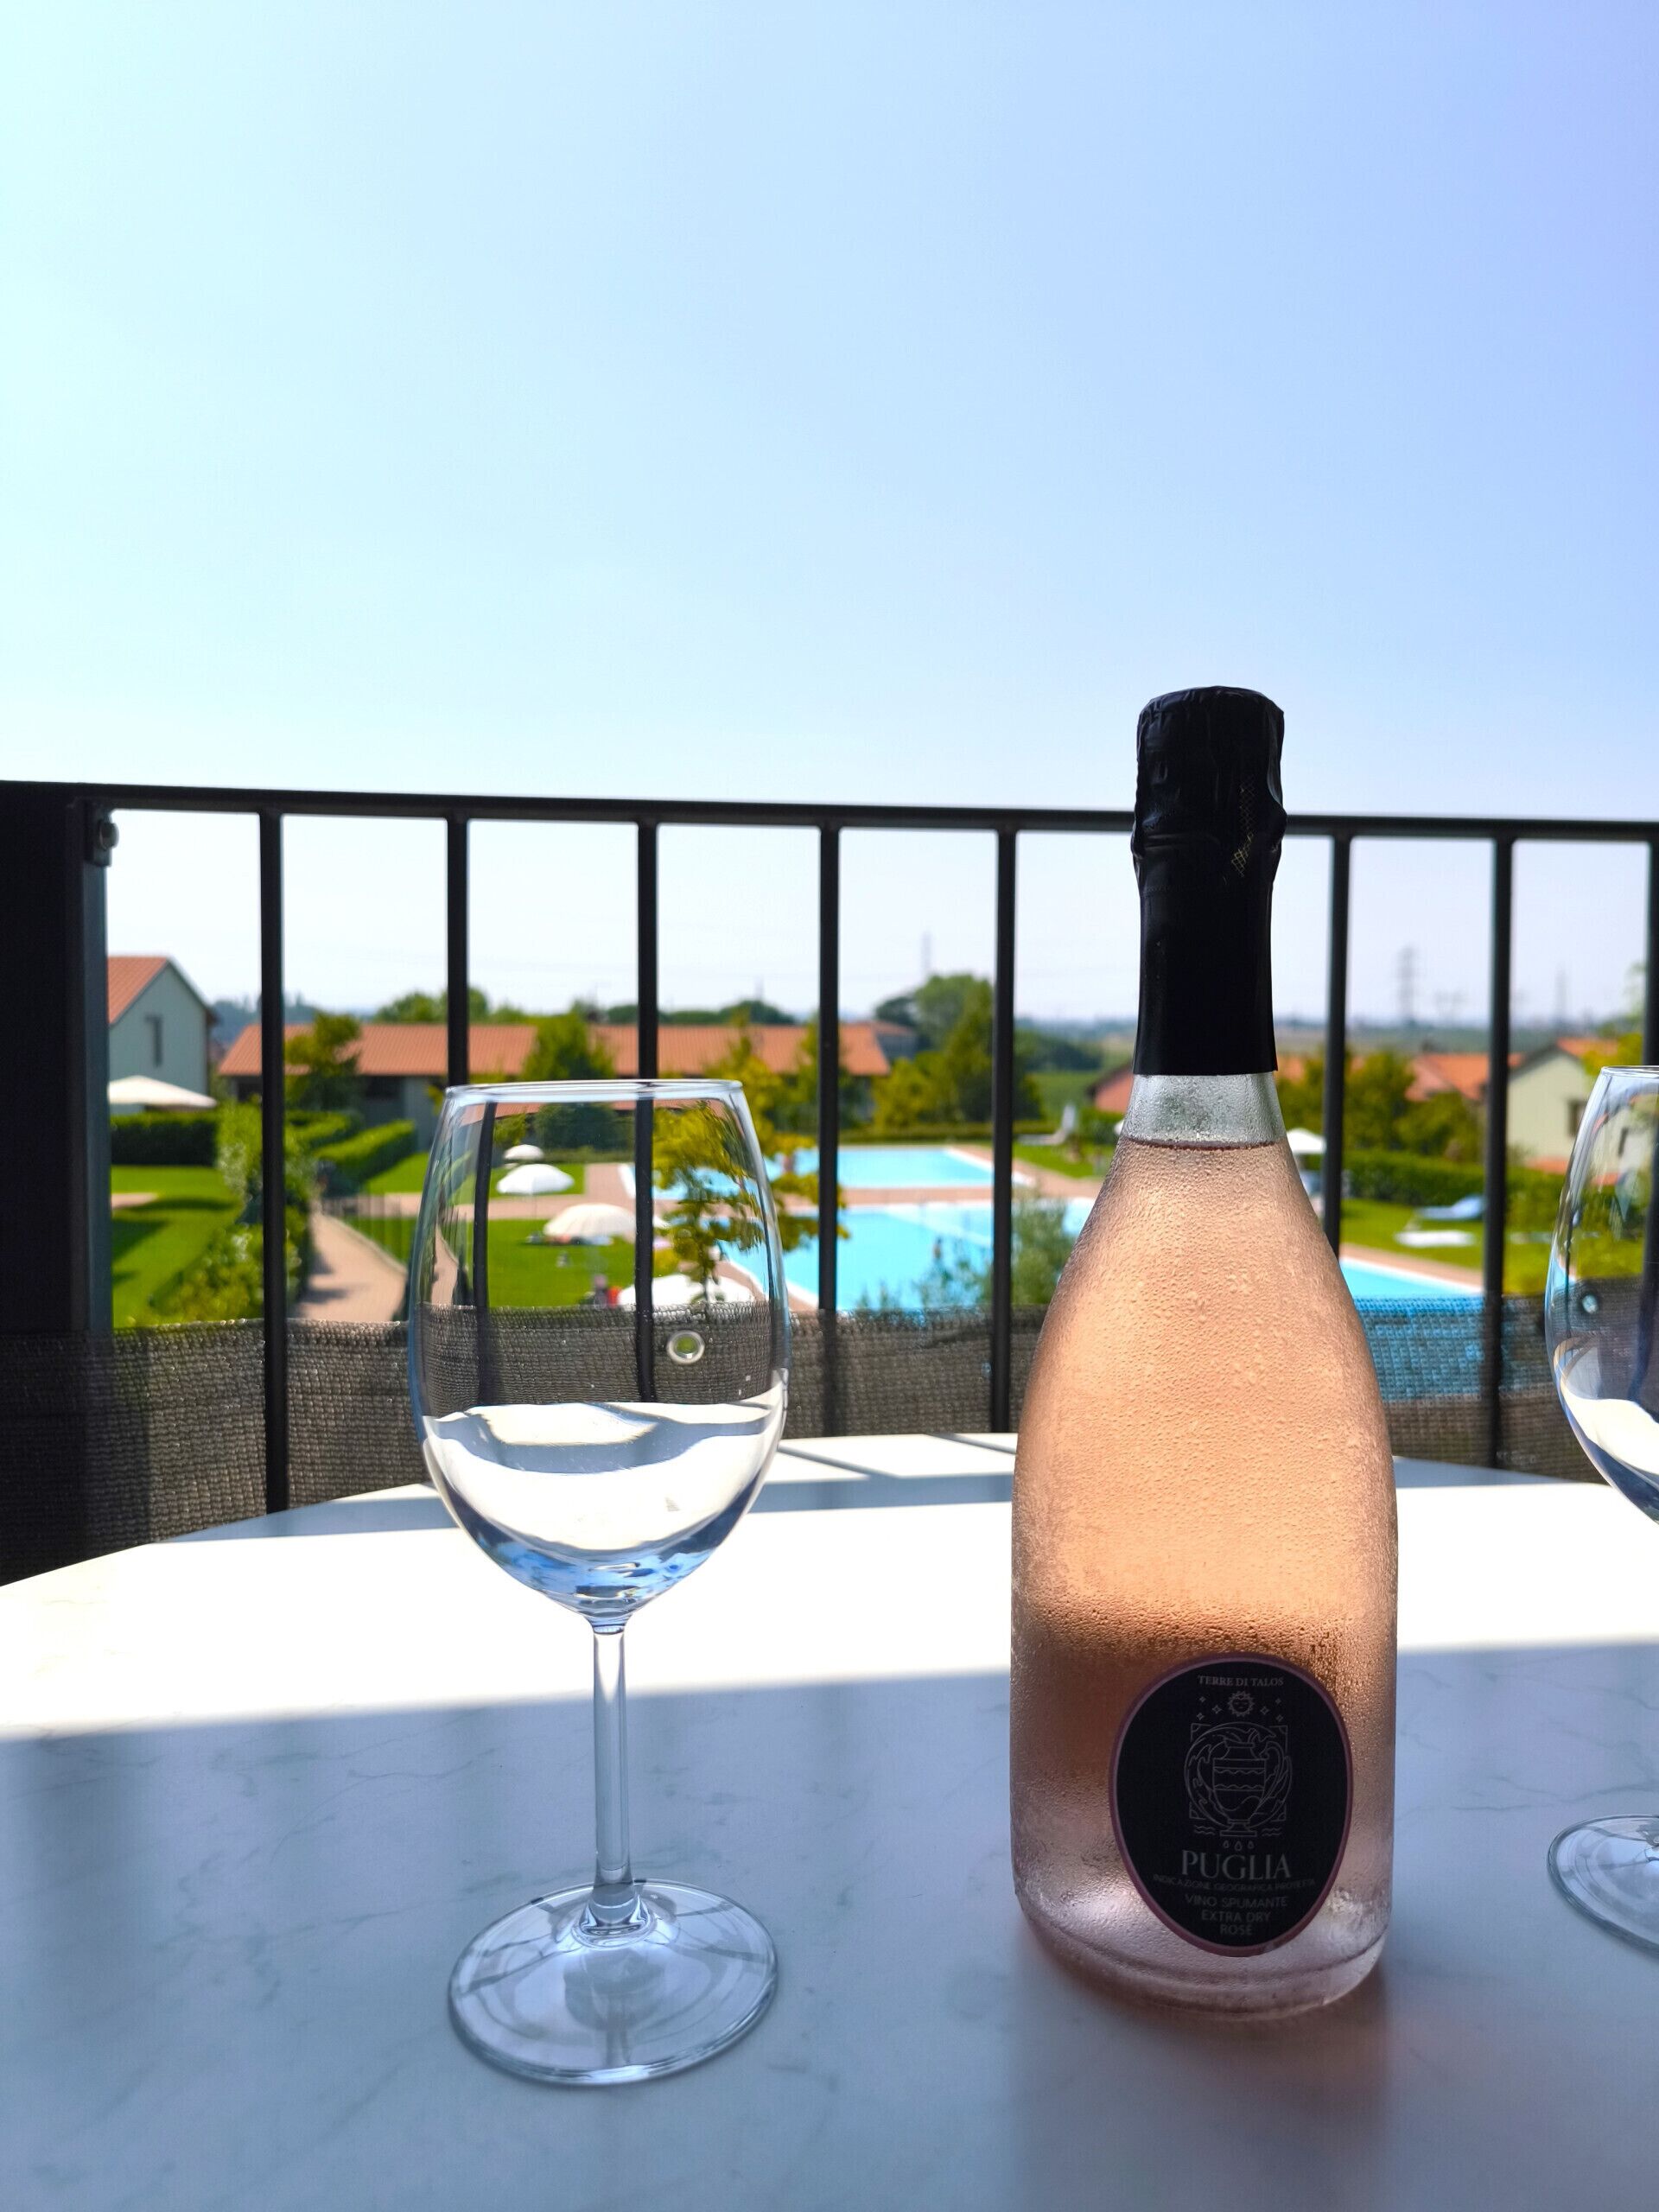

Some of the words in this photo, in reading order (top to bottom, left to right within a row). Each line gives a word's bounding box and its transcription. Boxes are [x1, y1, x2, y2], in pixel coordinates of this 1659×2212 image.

[1198, 1675, 1233, 1686] TERRE
[1236, 1677, 1249, 1687] DI
[1251, 1676, 1284, 1687] TALOS
[1181, 1849, 1292, 1880] PUGLIA
[1185, 1895, 1217, 1908] VINO
[1222, 1896, 1287, 1909] SPUMANTE
[1201, 1910, 1243, 1923] EXTRA
[1245, 1911, 1271, 1923] DRY
